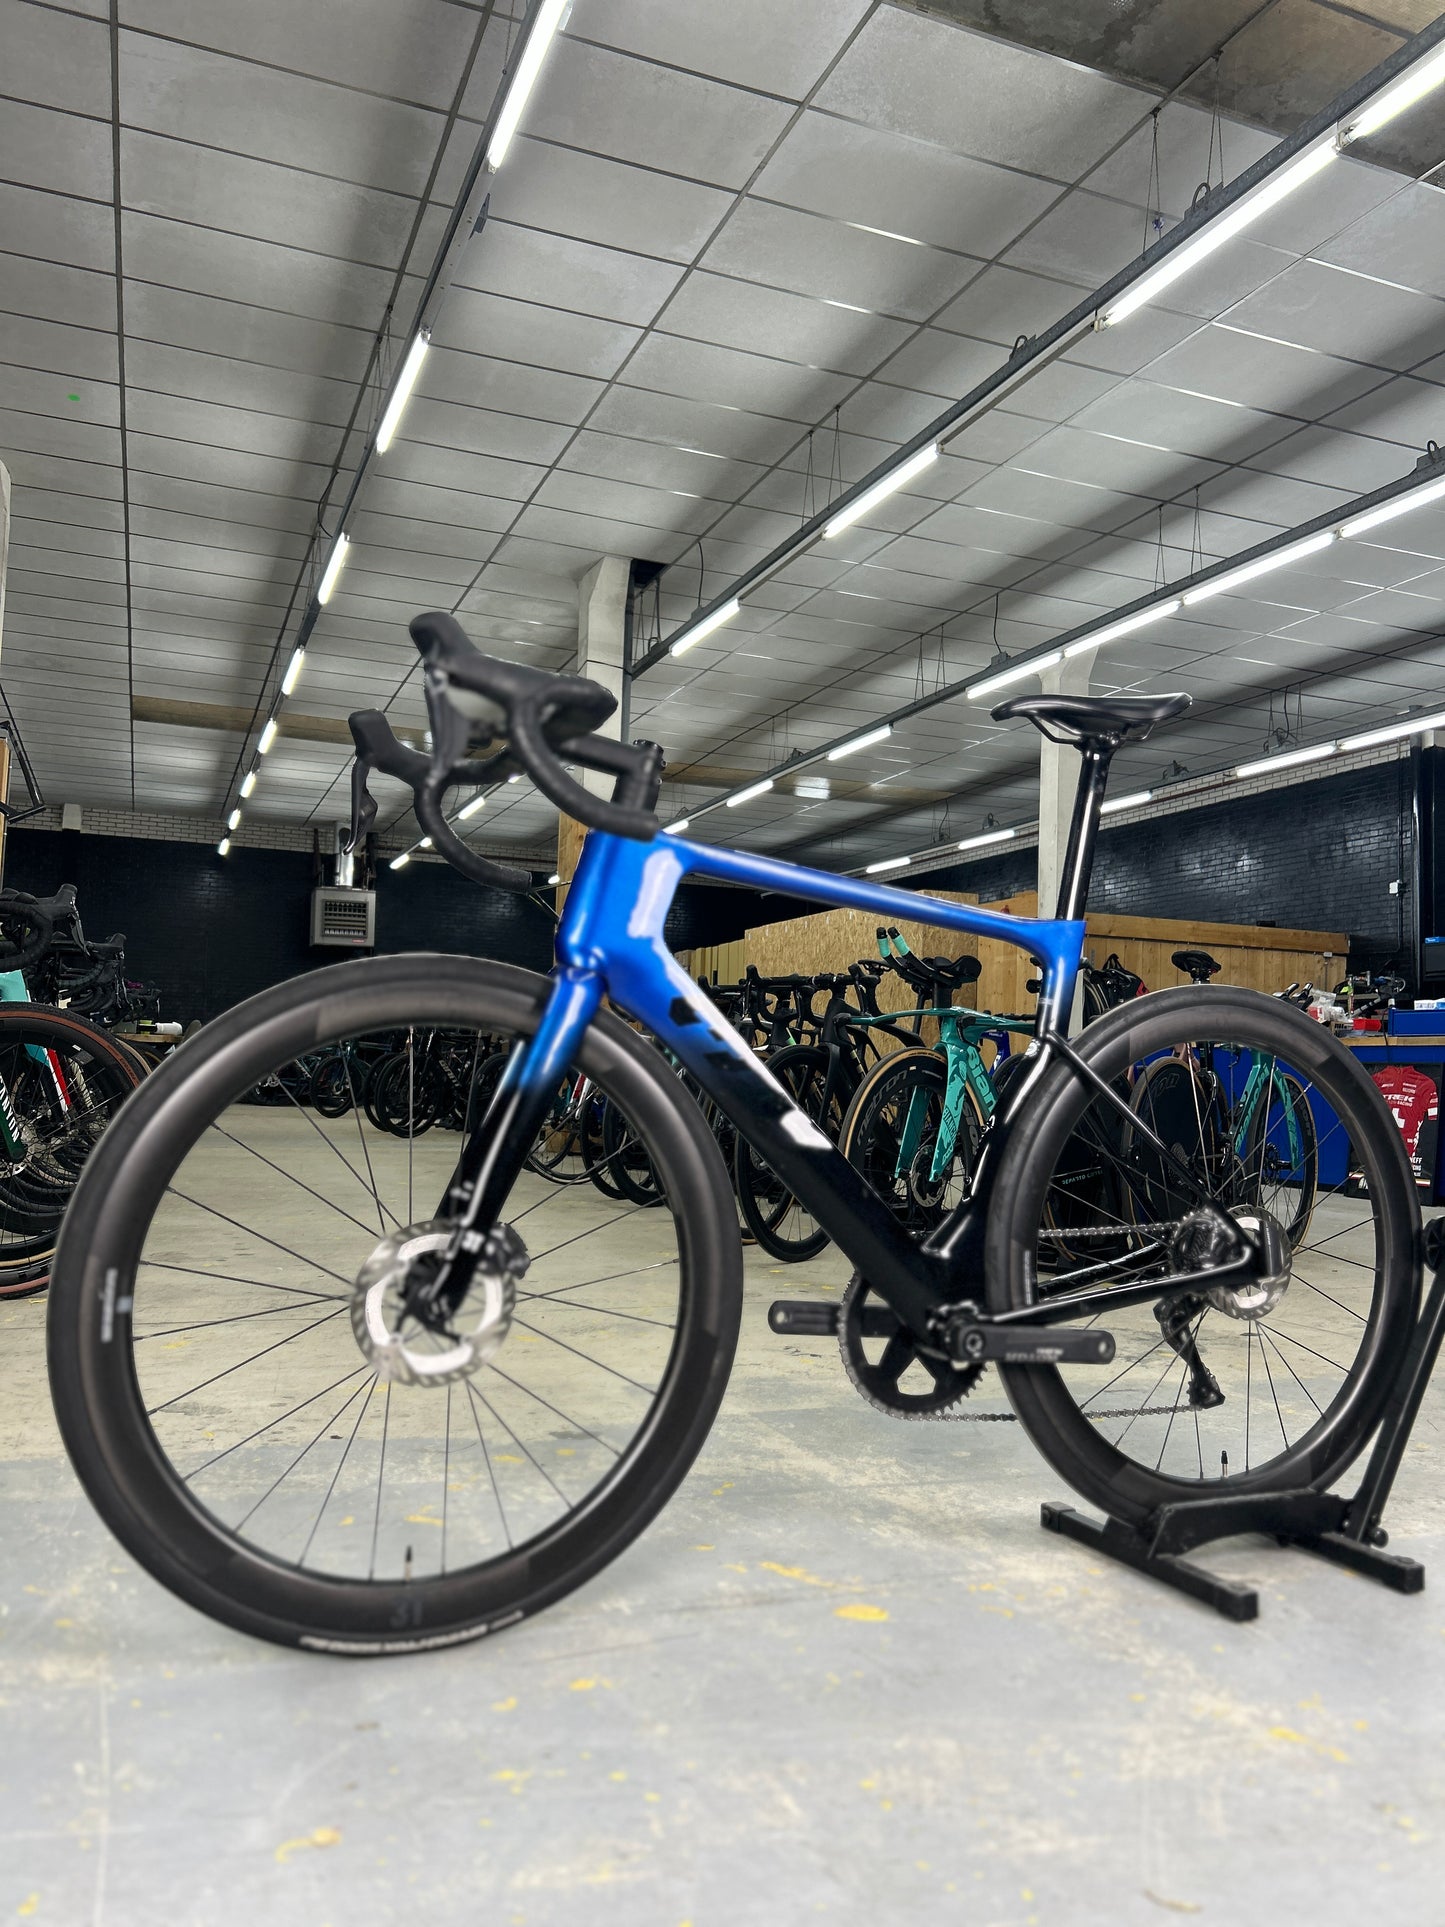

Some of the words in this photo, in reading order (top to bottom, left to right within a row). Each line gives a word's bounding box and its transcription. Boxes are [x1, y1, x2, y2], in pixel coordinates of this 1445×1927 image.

[0, 1072, 20, 1143] ANYON
[967, 1045, 997, 1112] Bian
[1382, 1093, 1415, 1103] TREK
